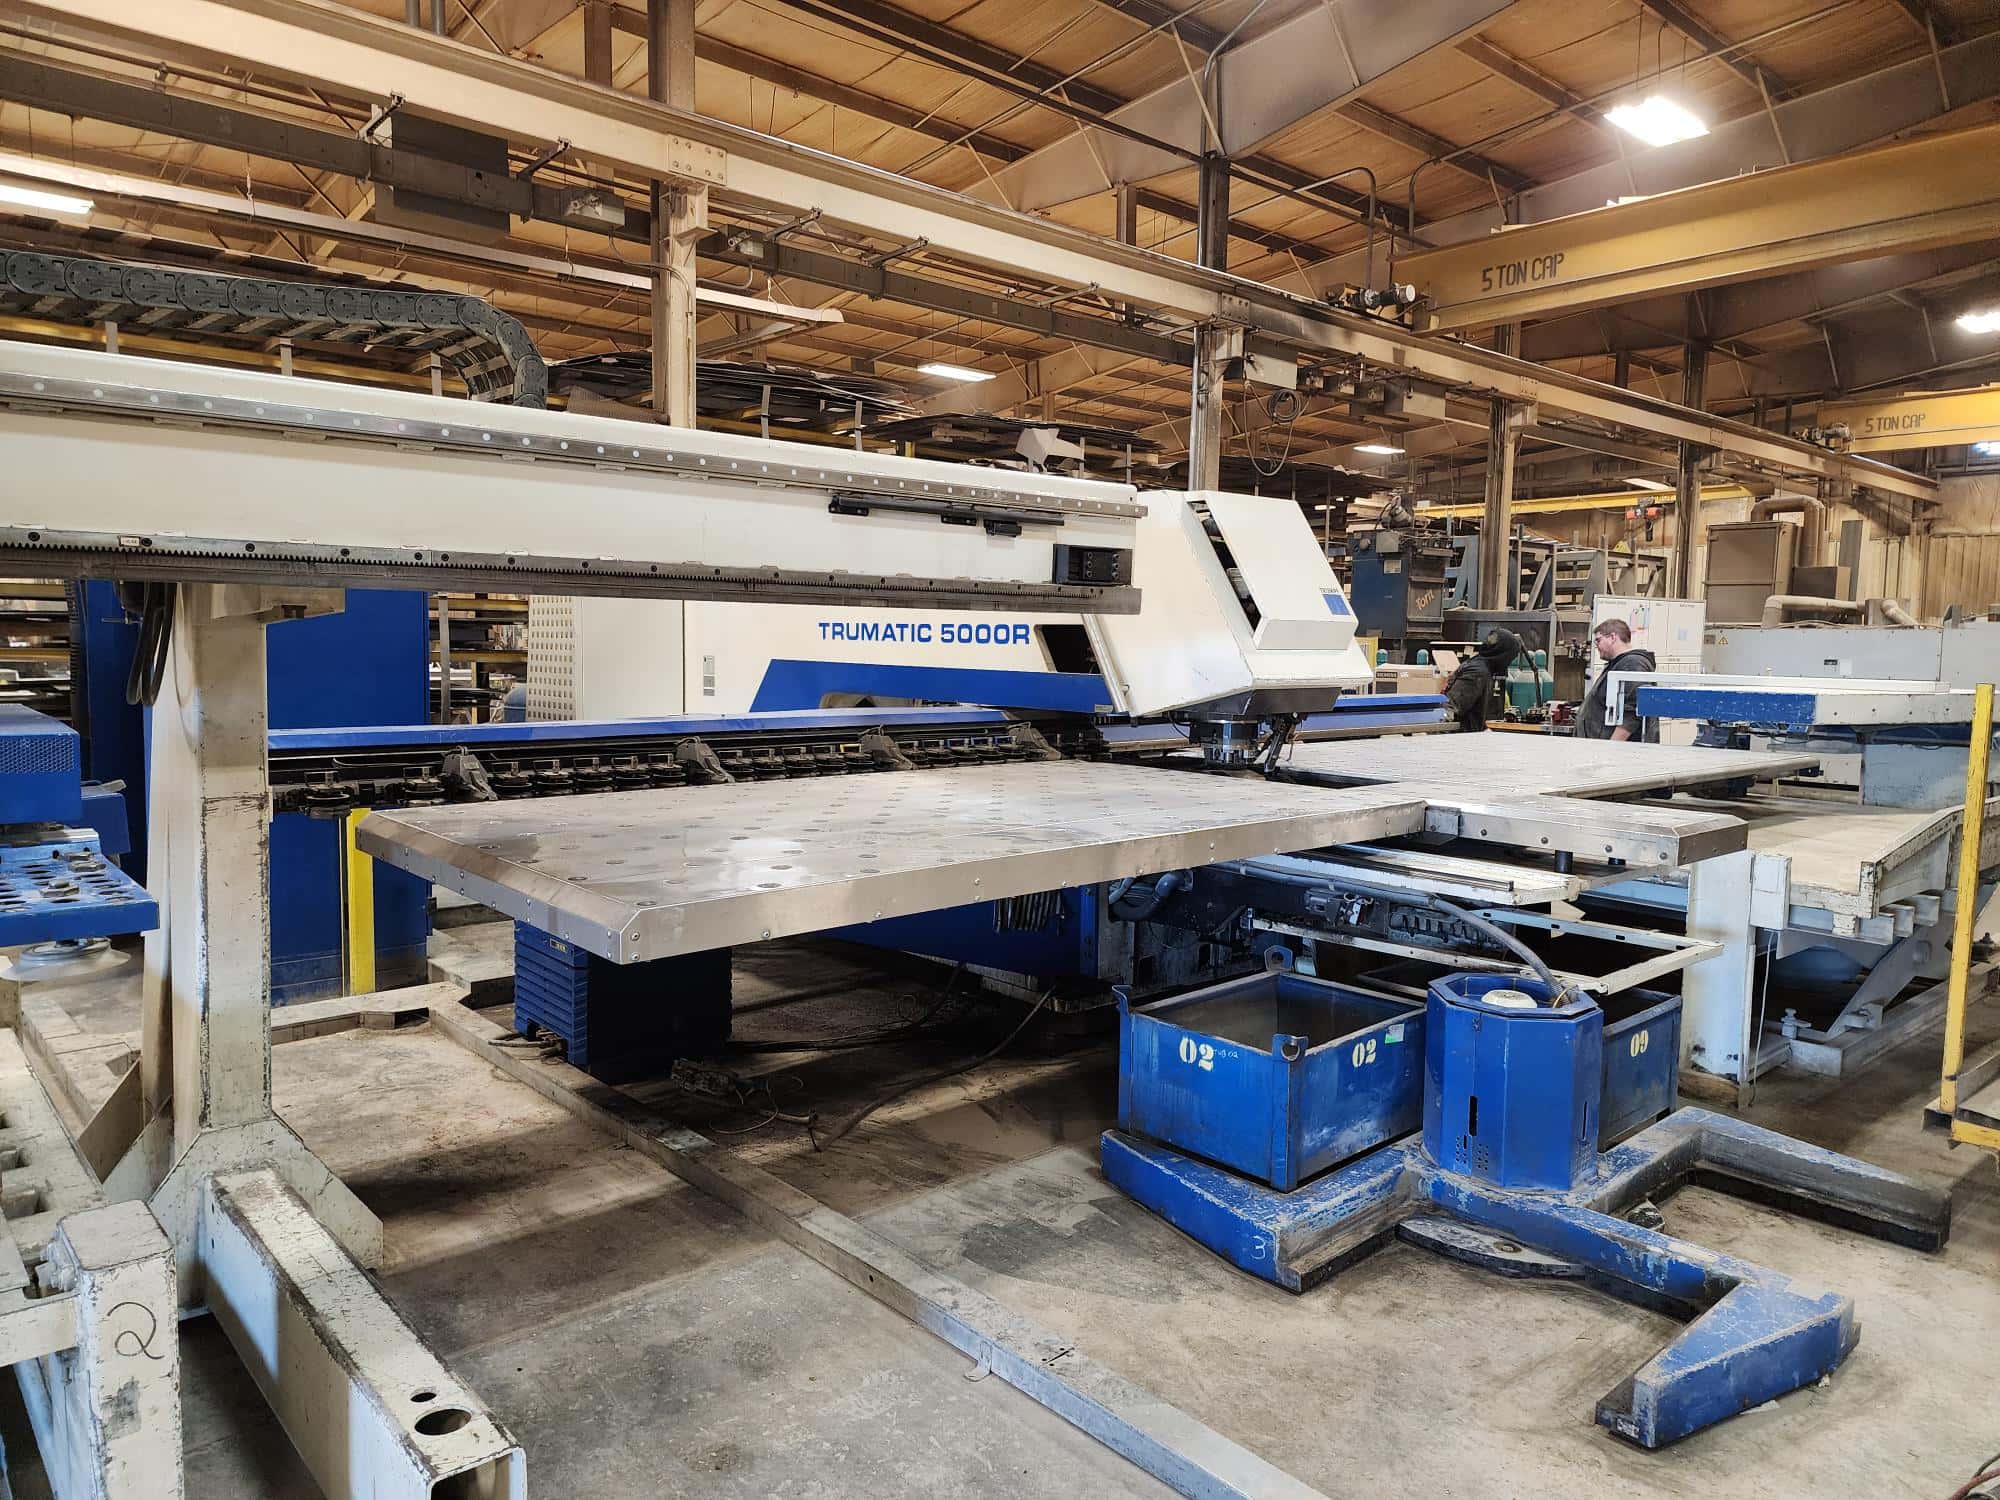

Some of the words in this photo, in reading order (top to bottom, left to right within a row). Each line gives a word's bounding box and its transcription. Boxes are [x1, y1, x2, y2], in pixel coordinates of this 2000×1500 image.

[1481, 267, 1494, 293] 5
[1496, 260, 1528, 289] TON
[1531, 252, 1565, 281] CAP
[1864, 417, 1874, 433] 5
[1876, 416, 1900, 432] TON
[1902, 413, 1926, 429] CAP
[818, 622, 932, 643] TRUMATIC
[940, 623, 1031, 645] 5000R
[1178, 1035, 1214, 1072] 02
[1352, 1038, 1377, 1068] 02
[1630, 1030, 1649, 1057] 09
[1250, 1235, 1266, 1260] 3
